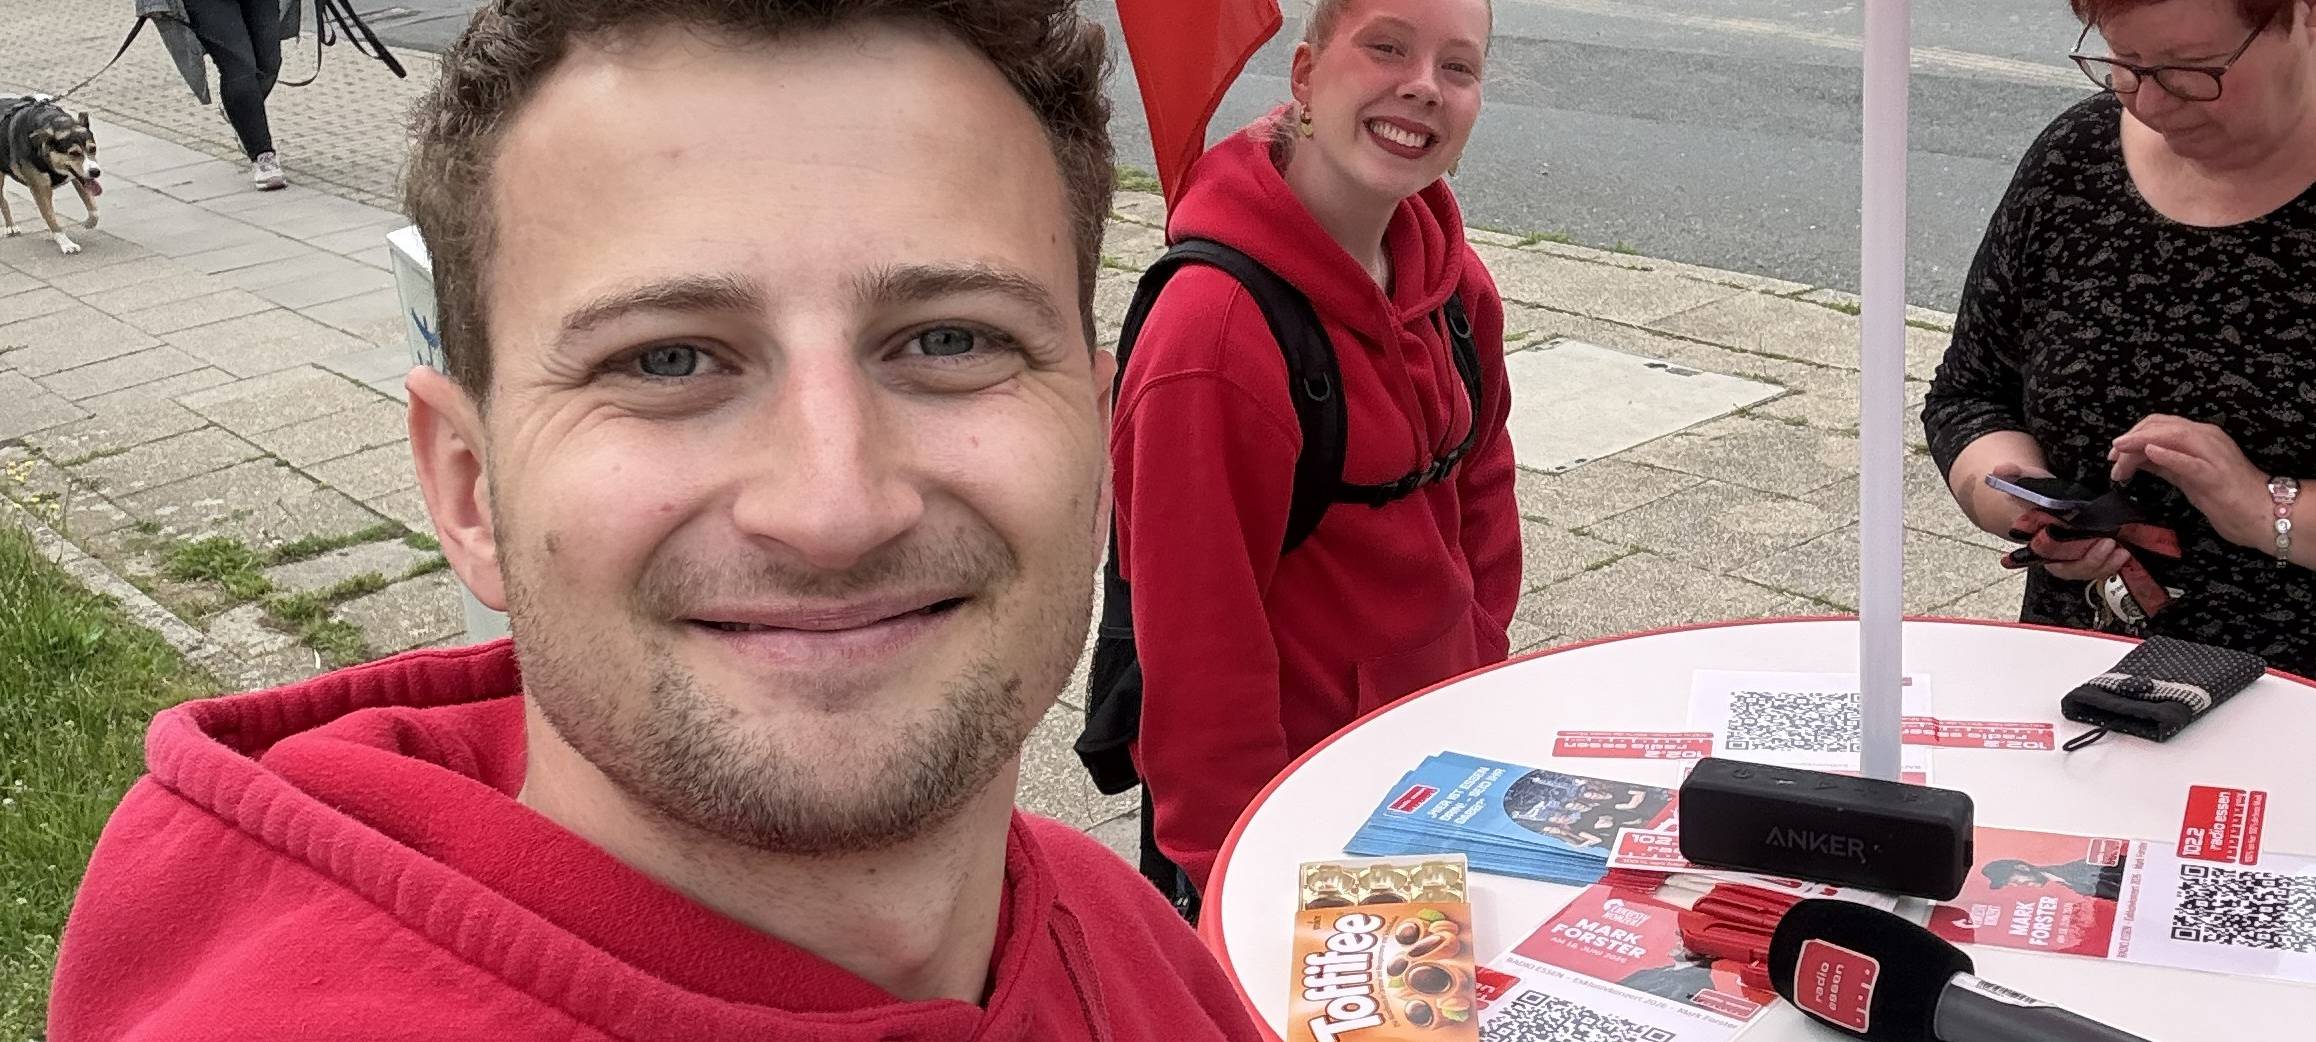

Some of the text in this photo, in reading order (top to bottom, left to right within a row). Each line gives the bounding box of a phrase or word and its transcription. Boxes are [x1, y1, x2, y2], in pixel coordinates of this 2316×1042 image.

[1564, 741, 1688, 750] radio essen
[1967, 732, 2028, 741] radio
[2209, 791, 2231, 851] radio essen
[1765, 825, 1867, 864] ANKER
[1575, 918, 1644, 945] MARK
[2008, 900, 2036, 936] MARK
[2028, 896, 2059, 945] FORSTER
[1551, 923, 1647, 959] FORSTER
[1303, 913, 1386, 1042] Toffifee
[1815, 961, 1830, 1004] radio
[1829, 963, 1845, 1011] essen
